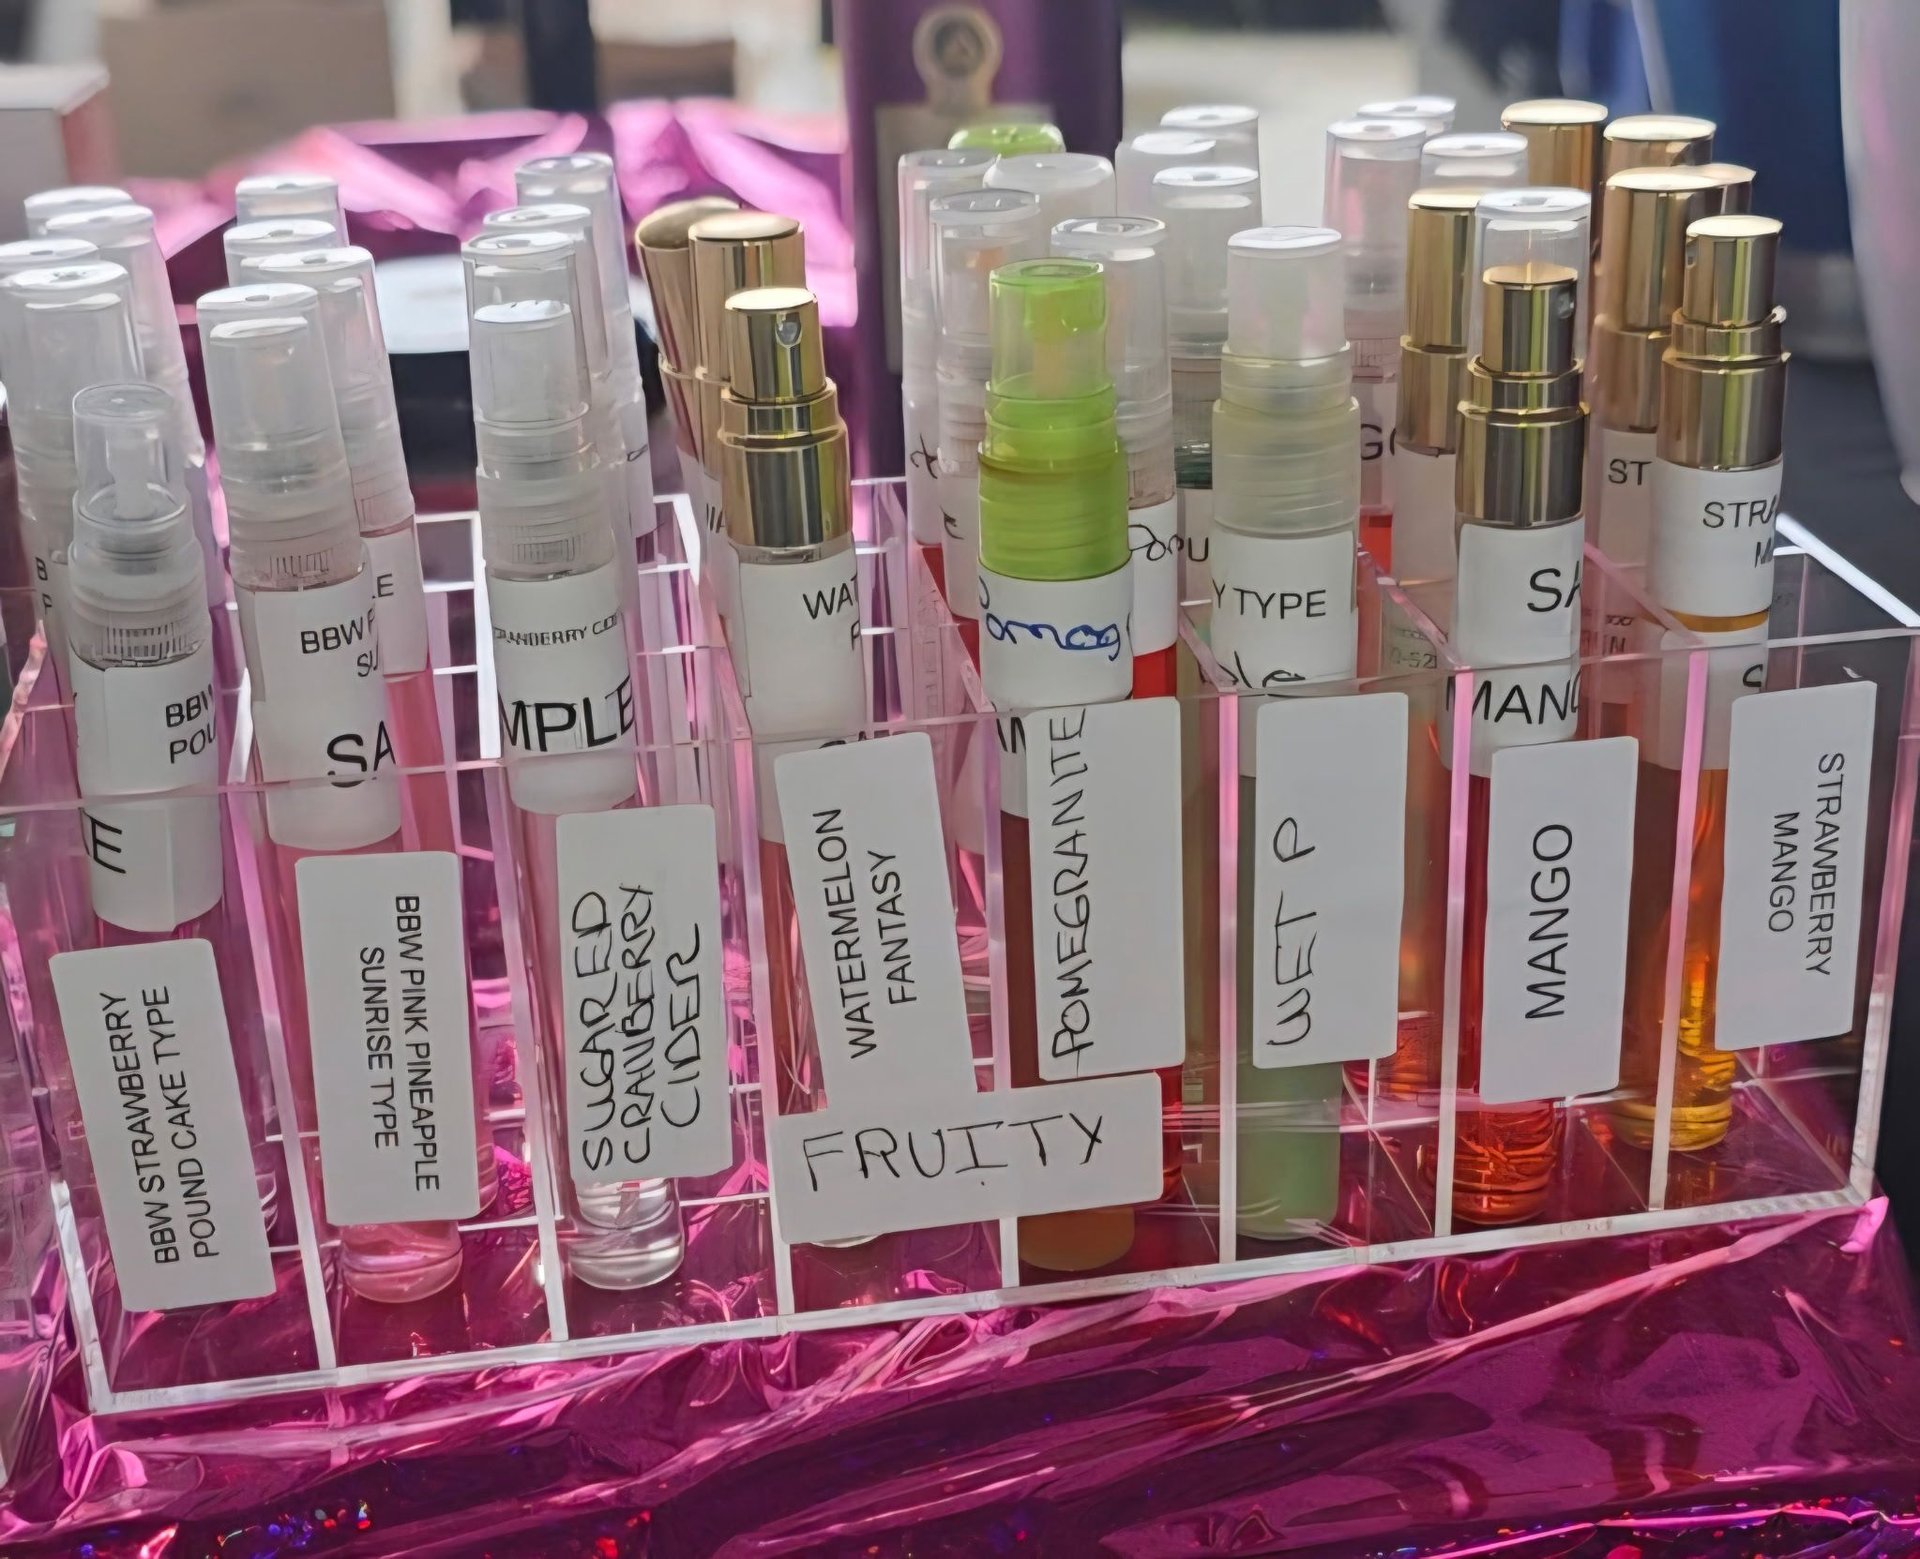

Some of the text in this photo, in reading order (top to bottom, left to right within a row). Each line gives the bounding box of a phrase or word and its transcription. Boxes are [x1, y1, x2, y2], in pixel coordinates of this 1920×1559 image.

[300, 616, 363, 655] BBW
[1232, 588, 1327, 620] TYPE
[812, 808, 877, 1059] WATERMELON
[867, 850, 917, 1005] FANTASY
[1525, 824, 1573, 1019] MANGO
[1768, 811, 1800, 932] MANGO
[1805, 752, 1845, 976] STRAWBERRY
[142, 986, 219, 1258] POUND CAKE TYPE
[360, 946, 399, 1148] SUNRISE TYPE
[395, 896, 439, 1191] BBW PINK PINEAPPLE
[572, 891, 618, 1170] SUGARED
[660, 922, 701, 1128] CIDER
[99, 992, 179, 1263] BBW STRAWBERRY
[803, 1112, 1103, 1192] FRUITY
